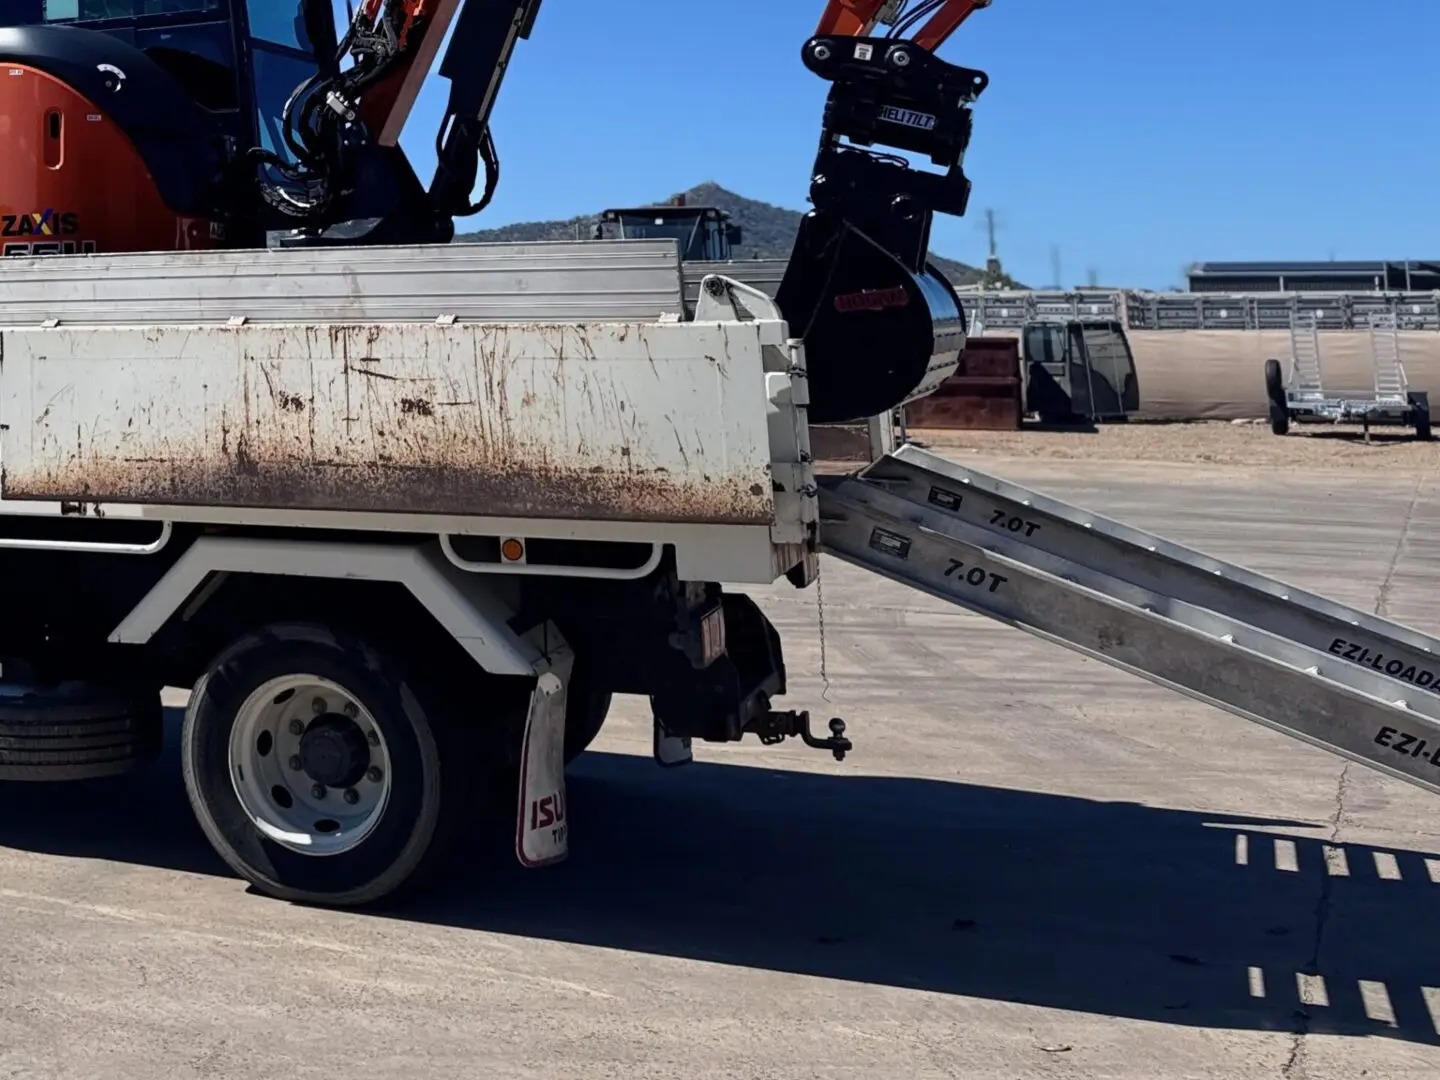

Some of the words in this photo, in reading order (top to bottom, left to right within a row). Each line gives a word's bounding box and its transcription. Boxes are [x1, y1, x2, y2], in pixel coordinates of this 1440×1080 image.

[1, 208, 80, 236] ZAXIS
[989, 509, 1041, 538] 7.0T
[944, 558, 1008, 593] 7.0T
